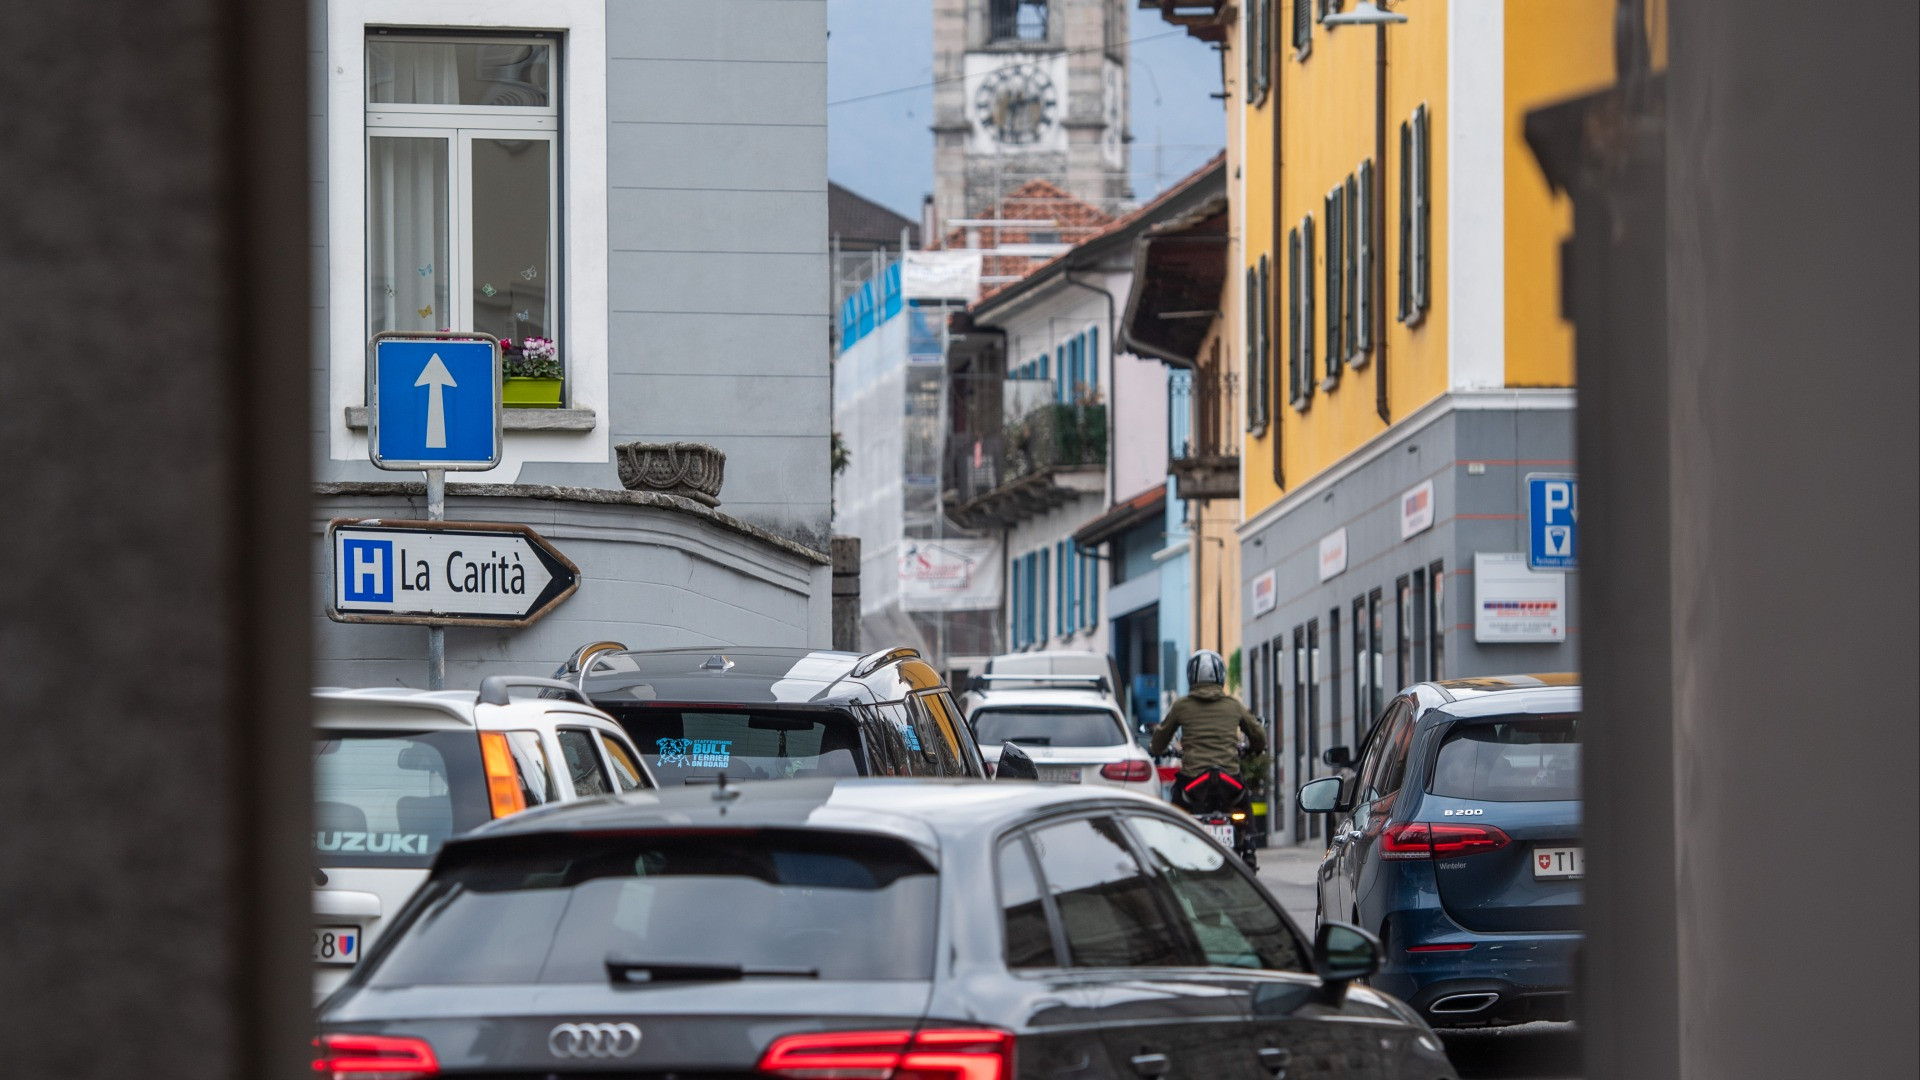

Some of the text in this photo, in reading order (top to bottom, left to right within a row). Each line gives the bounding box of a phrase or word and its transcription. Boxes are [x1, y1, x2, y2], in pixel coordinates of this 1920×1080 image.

[1545, 482, 1569, 524] P
[353, 547, 525, 594] H La Carità
[693, 744, 730, 754] BULL
[693, 754, 729, 762] TERRIER
[1455, 808, 1484, 816] 200
[1439, 862, 1467, 870] Winteler
[1555, 851, 1574, 871] TI
